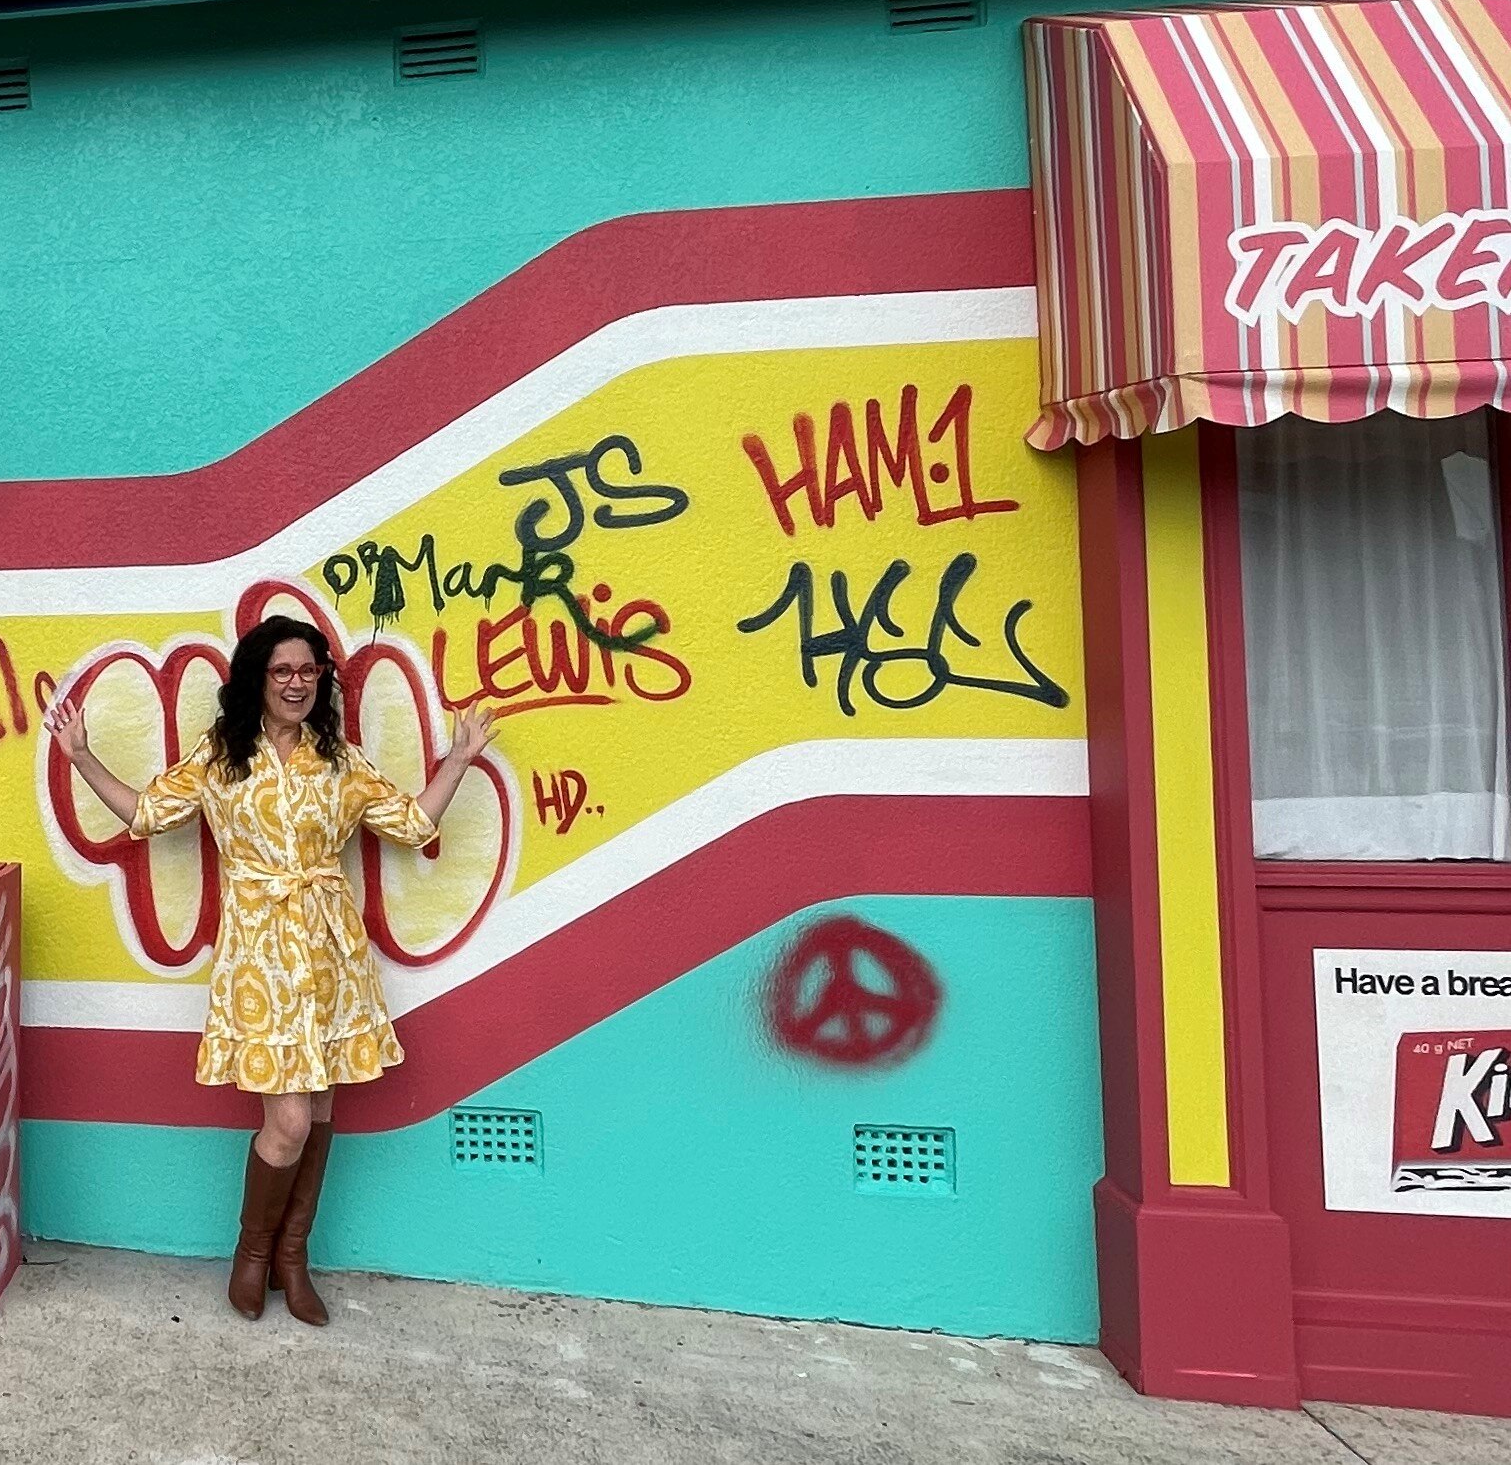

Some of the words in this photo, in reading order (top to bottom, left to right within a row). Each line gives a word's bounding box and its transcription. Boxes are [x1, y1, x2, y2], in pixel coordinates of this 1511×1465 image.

[1232, 216, 1511, 314] TAKE
[1334, 967, 1415, 995] Have
[1421, 973, 1440, 996] a
[1412, 1042, 1429, 1054] 40
[1434, 1043, 1443, 1055] g
[1447, 1037, 1475, 1052] NET
[1430, 1046, 1511, 1150] Ki
